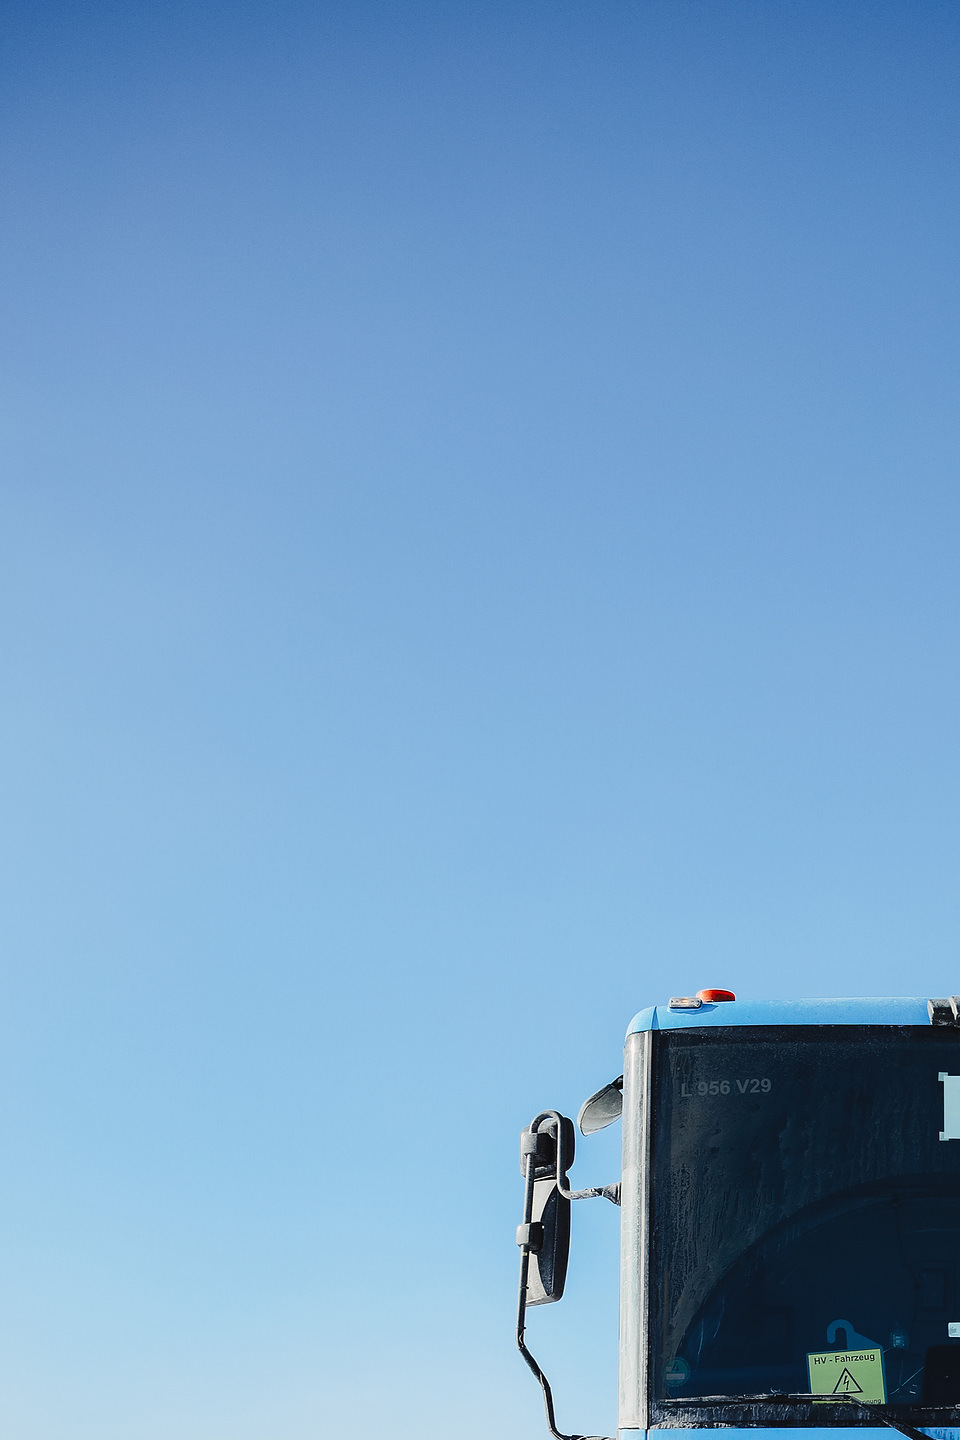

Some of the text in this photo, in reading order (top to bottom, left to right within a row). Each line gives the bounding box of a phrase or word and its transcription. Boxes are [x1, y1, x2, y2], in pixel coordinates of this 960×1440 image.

[681, 1078, 772, 1097] L 956 V29
[813, 1356, 827, 1365] HV
[834, 1354, 875, 1363] Fahrzeug
